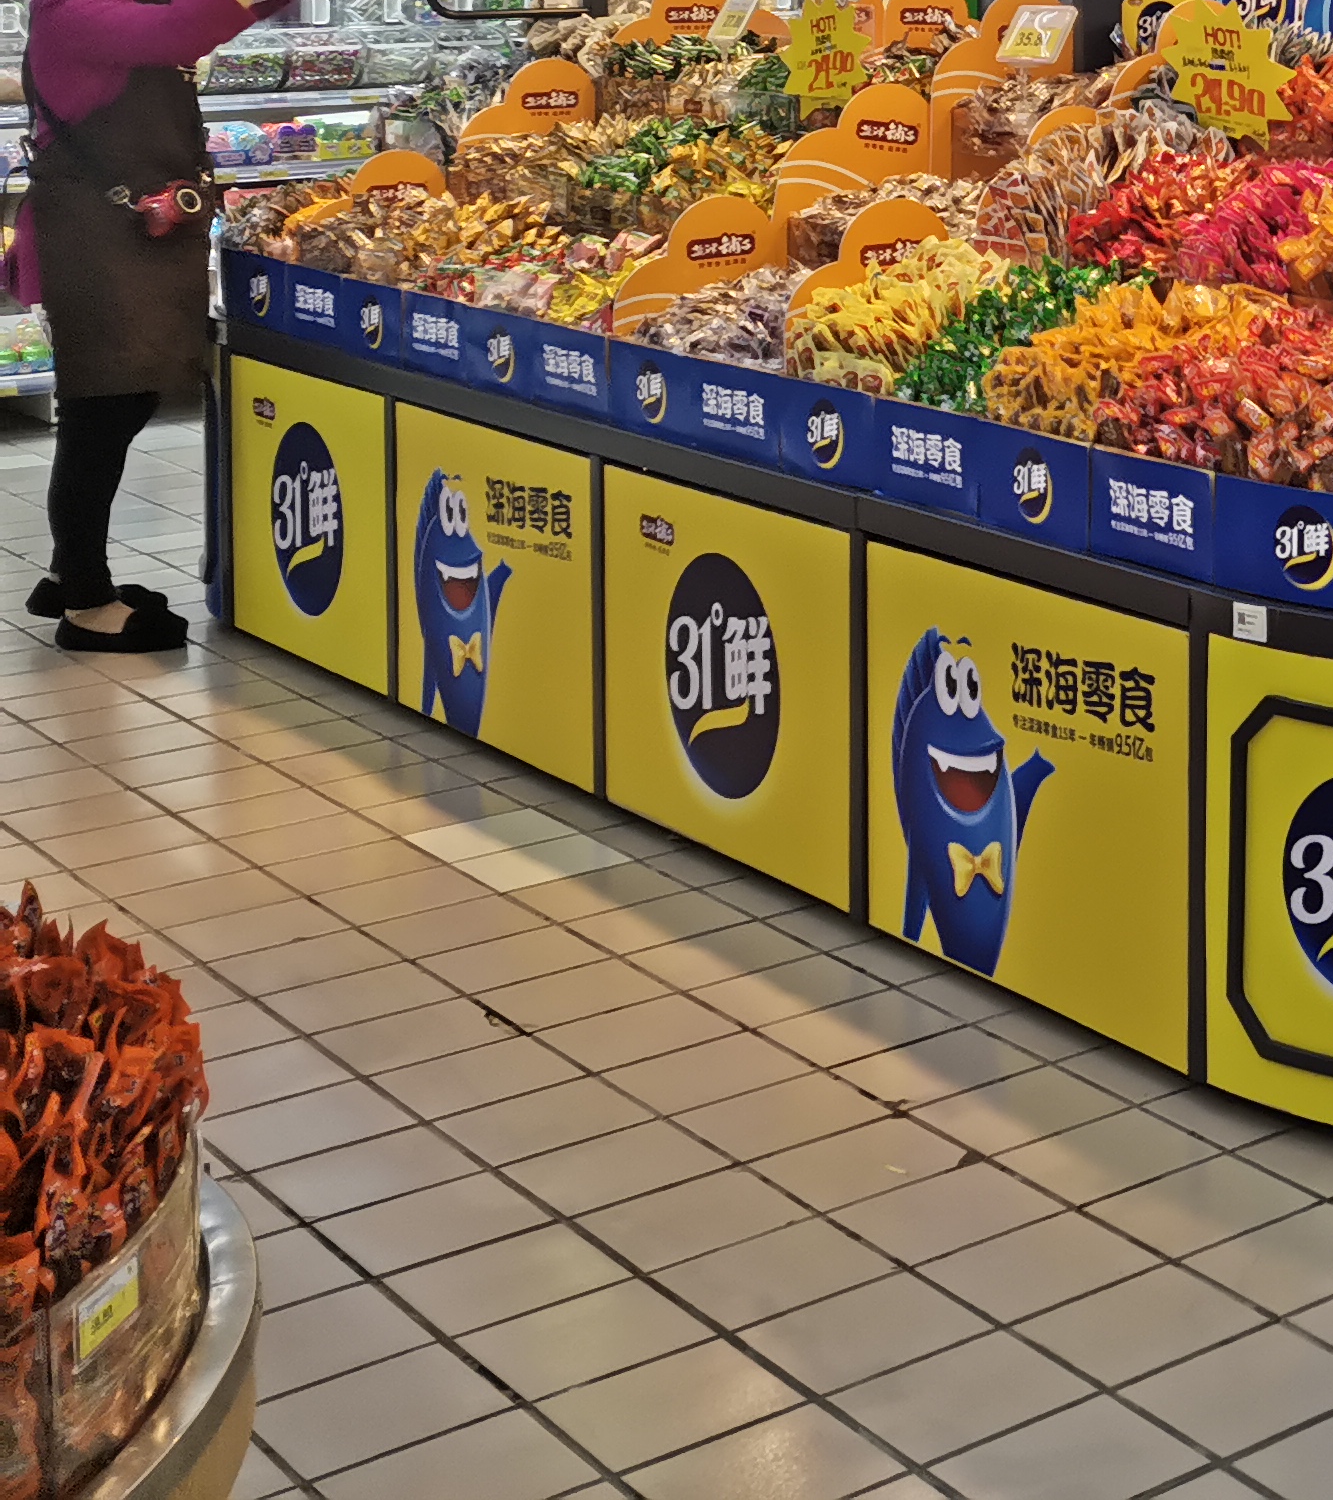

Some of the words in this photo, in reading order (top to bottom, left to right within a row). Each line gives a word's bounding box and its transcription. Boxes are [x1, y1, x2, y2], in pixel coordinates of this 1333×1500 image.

[809, 14, 837, 35] HOT!
[1014, 31, 1051, 47] 35.8
[1202, 25, 1242, 50] HOT!
[485, 475, 573, 541] 深海零食
[1108, 477, 1196, 534] 深海零食
[1010, 642, 1157, 734] 深海零食
